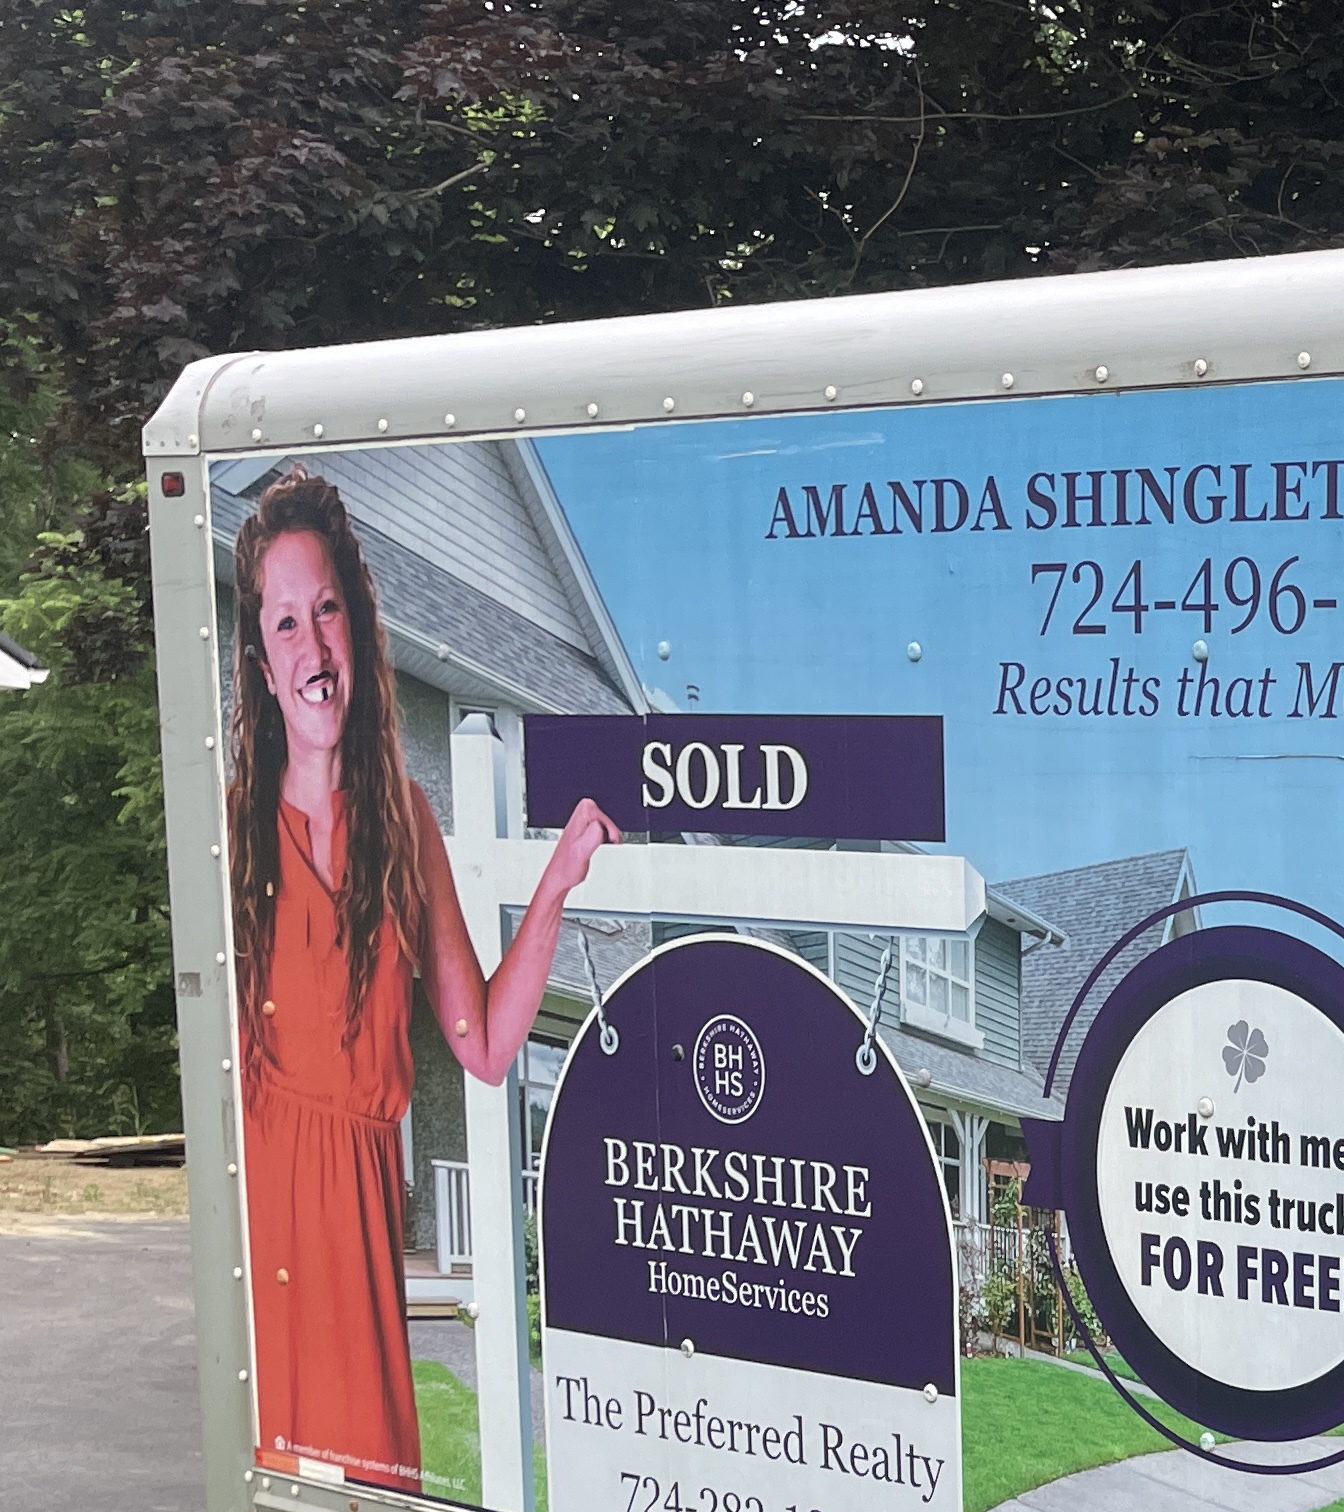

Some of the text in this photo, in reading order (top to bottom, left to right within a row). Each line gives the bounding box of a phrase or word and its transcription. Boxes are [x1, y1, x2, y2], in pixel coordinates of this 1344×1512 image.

[765, 480, 1012, 540] AMANDA
[993, 659, 1160, 719] Results
[1175, 656, 1278, 720] that
[642, 741, 808, 810] SOLD
[714, 1043, 743, 1070] BH
[715, 1070, 744, 1097] HS
[1124, 1106, 1209, 1156] Work
[1216, 1116, 1291, 1165] with
[603, 1137, 872, 1218] BERKSHIRE
[1134, 1180, 1190, 1217] use
[1200, 1179, 1261, 1226] this
[613, 1198, 863, 1278] HATHAWAY
[1140, 1232, 1225, 1298] FOR
[647, 1261, 830, 1318] HomeServices
[555, 1375, 944, 1502] The Preferred Realty
